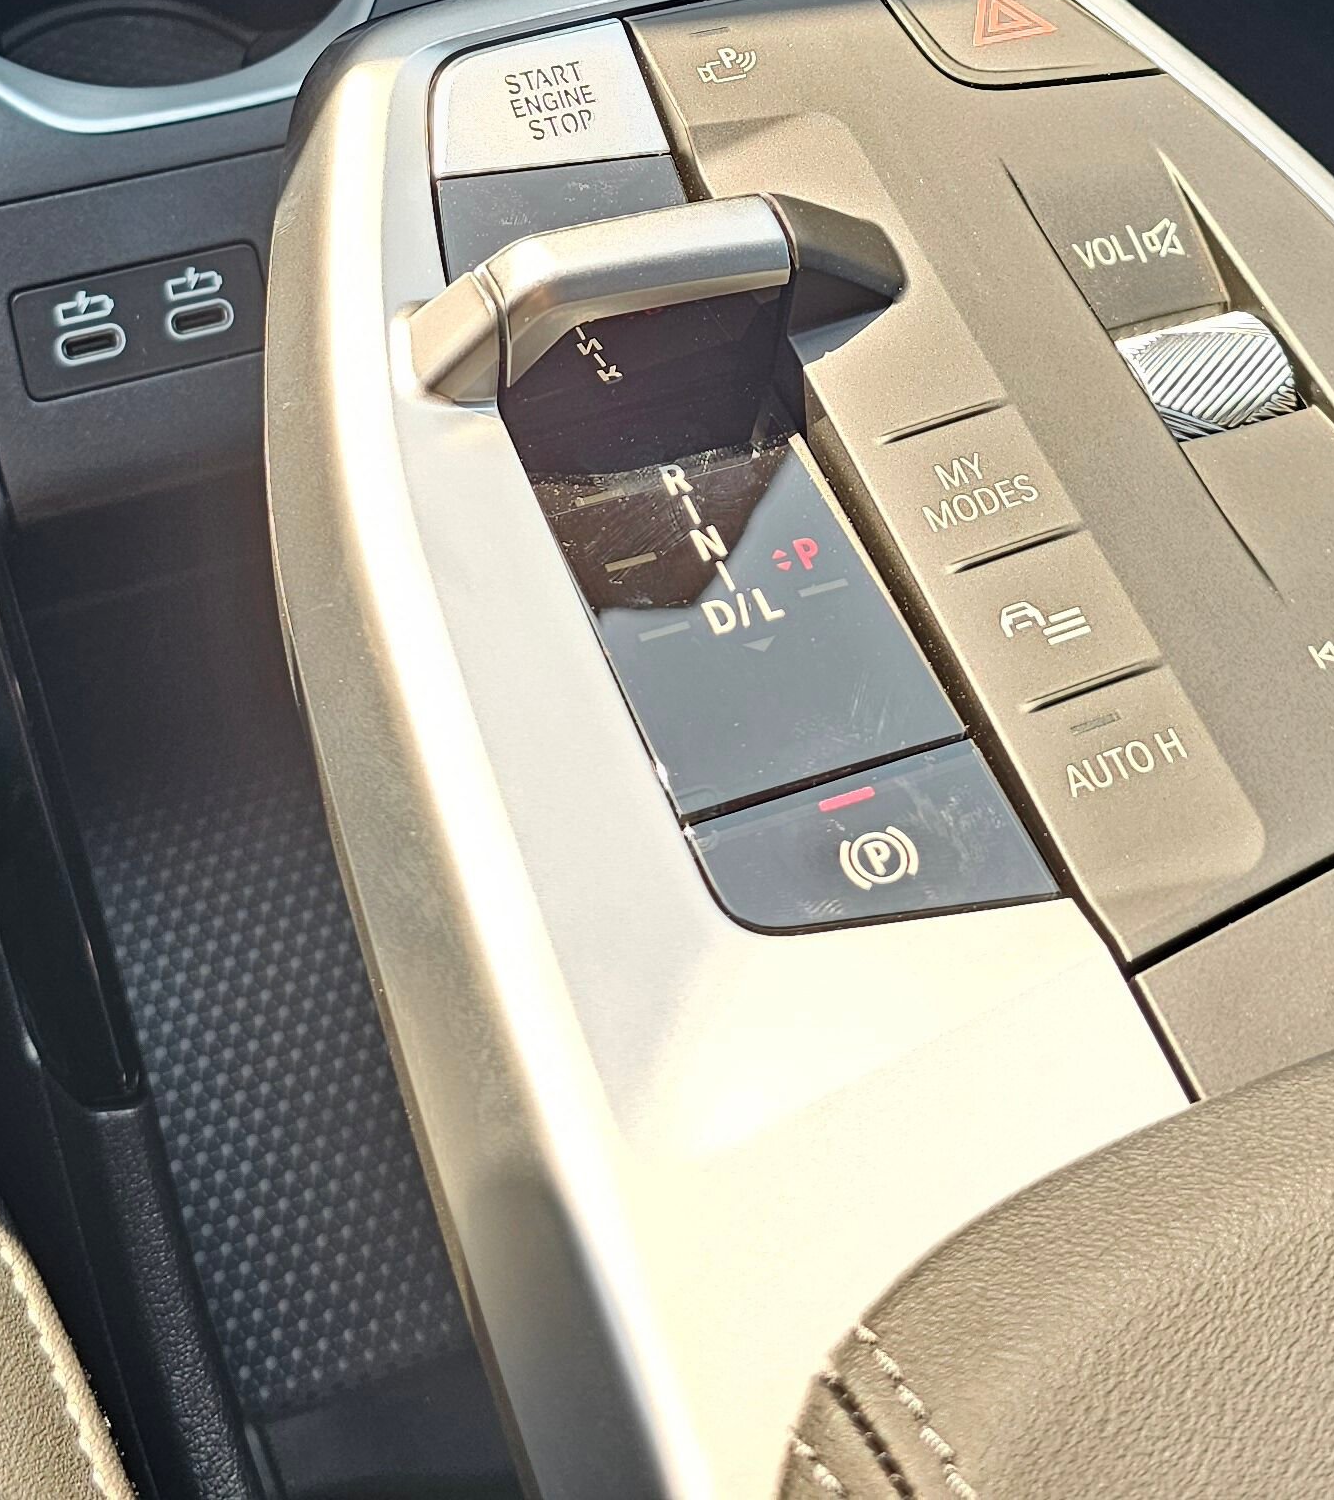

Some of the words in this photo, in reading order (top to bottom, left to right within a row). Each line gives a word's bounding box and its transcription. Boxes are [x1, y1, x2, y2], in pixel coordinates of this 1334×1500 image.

[504, 61, 582, 95] START
[510, 85, 596, 119] ENGINE
[528, 109, 593, 141] STOP
[1071, 234, 1135, 269] VOL
[659, 464, 694, 496] R
[933, 452, 983, 491] MY
[921, 473, 1039, 533] MODES
[689, 524, 729, 562] N
[792, 537, 819, 570] P
[700, 587, 786, 636] D/L
[1066, 740, 1155, 798] AUTO
[1153, 726, 1188, 764] H
